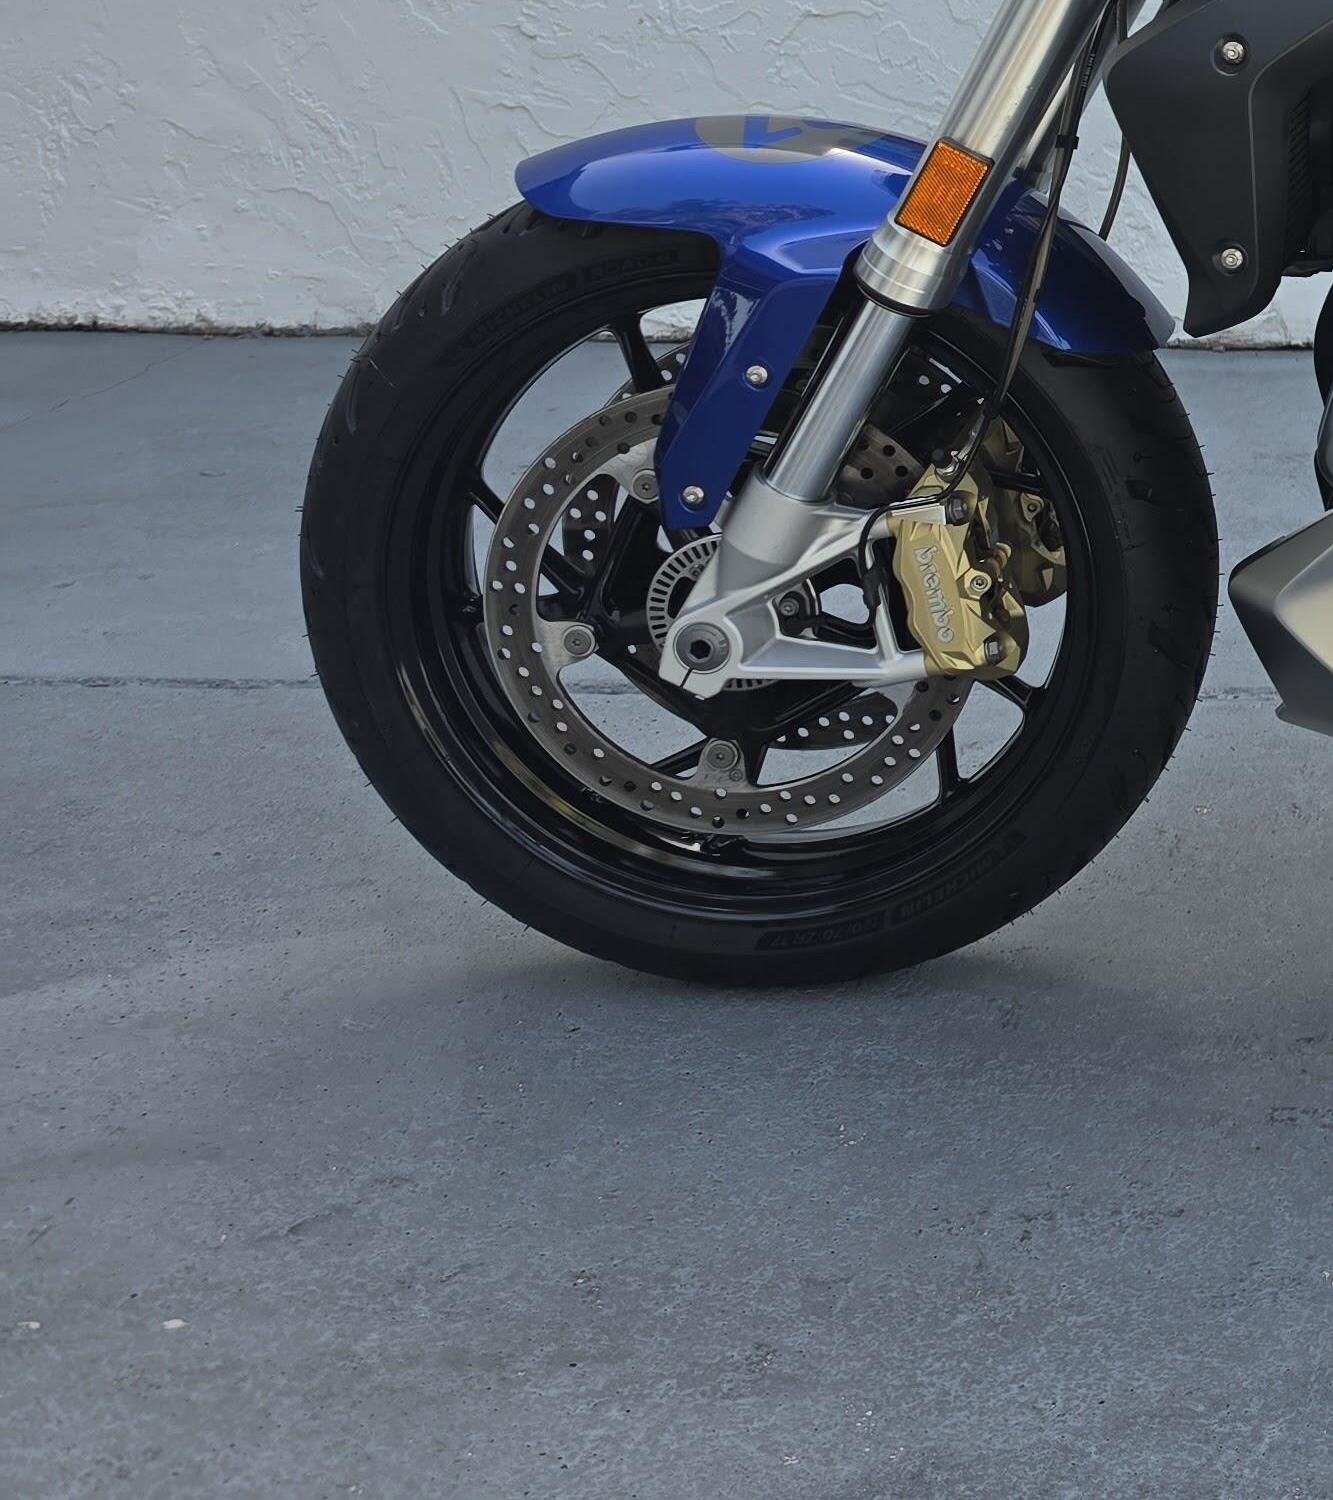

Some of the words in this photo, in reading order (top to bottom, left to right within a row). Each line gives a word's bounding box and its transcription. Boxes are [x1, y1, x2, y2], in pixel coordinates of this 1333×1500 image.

[469, 279, 570, 345] MICHELIN
[912, 544, 956, 643] brembo
[894, 852, 993, 921] MICHELIN
[821, 915, 879, 940] 120/70
